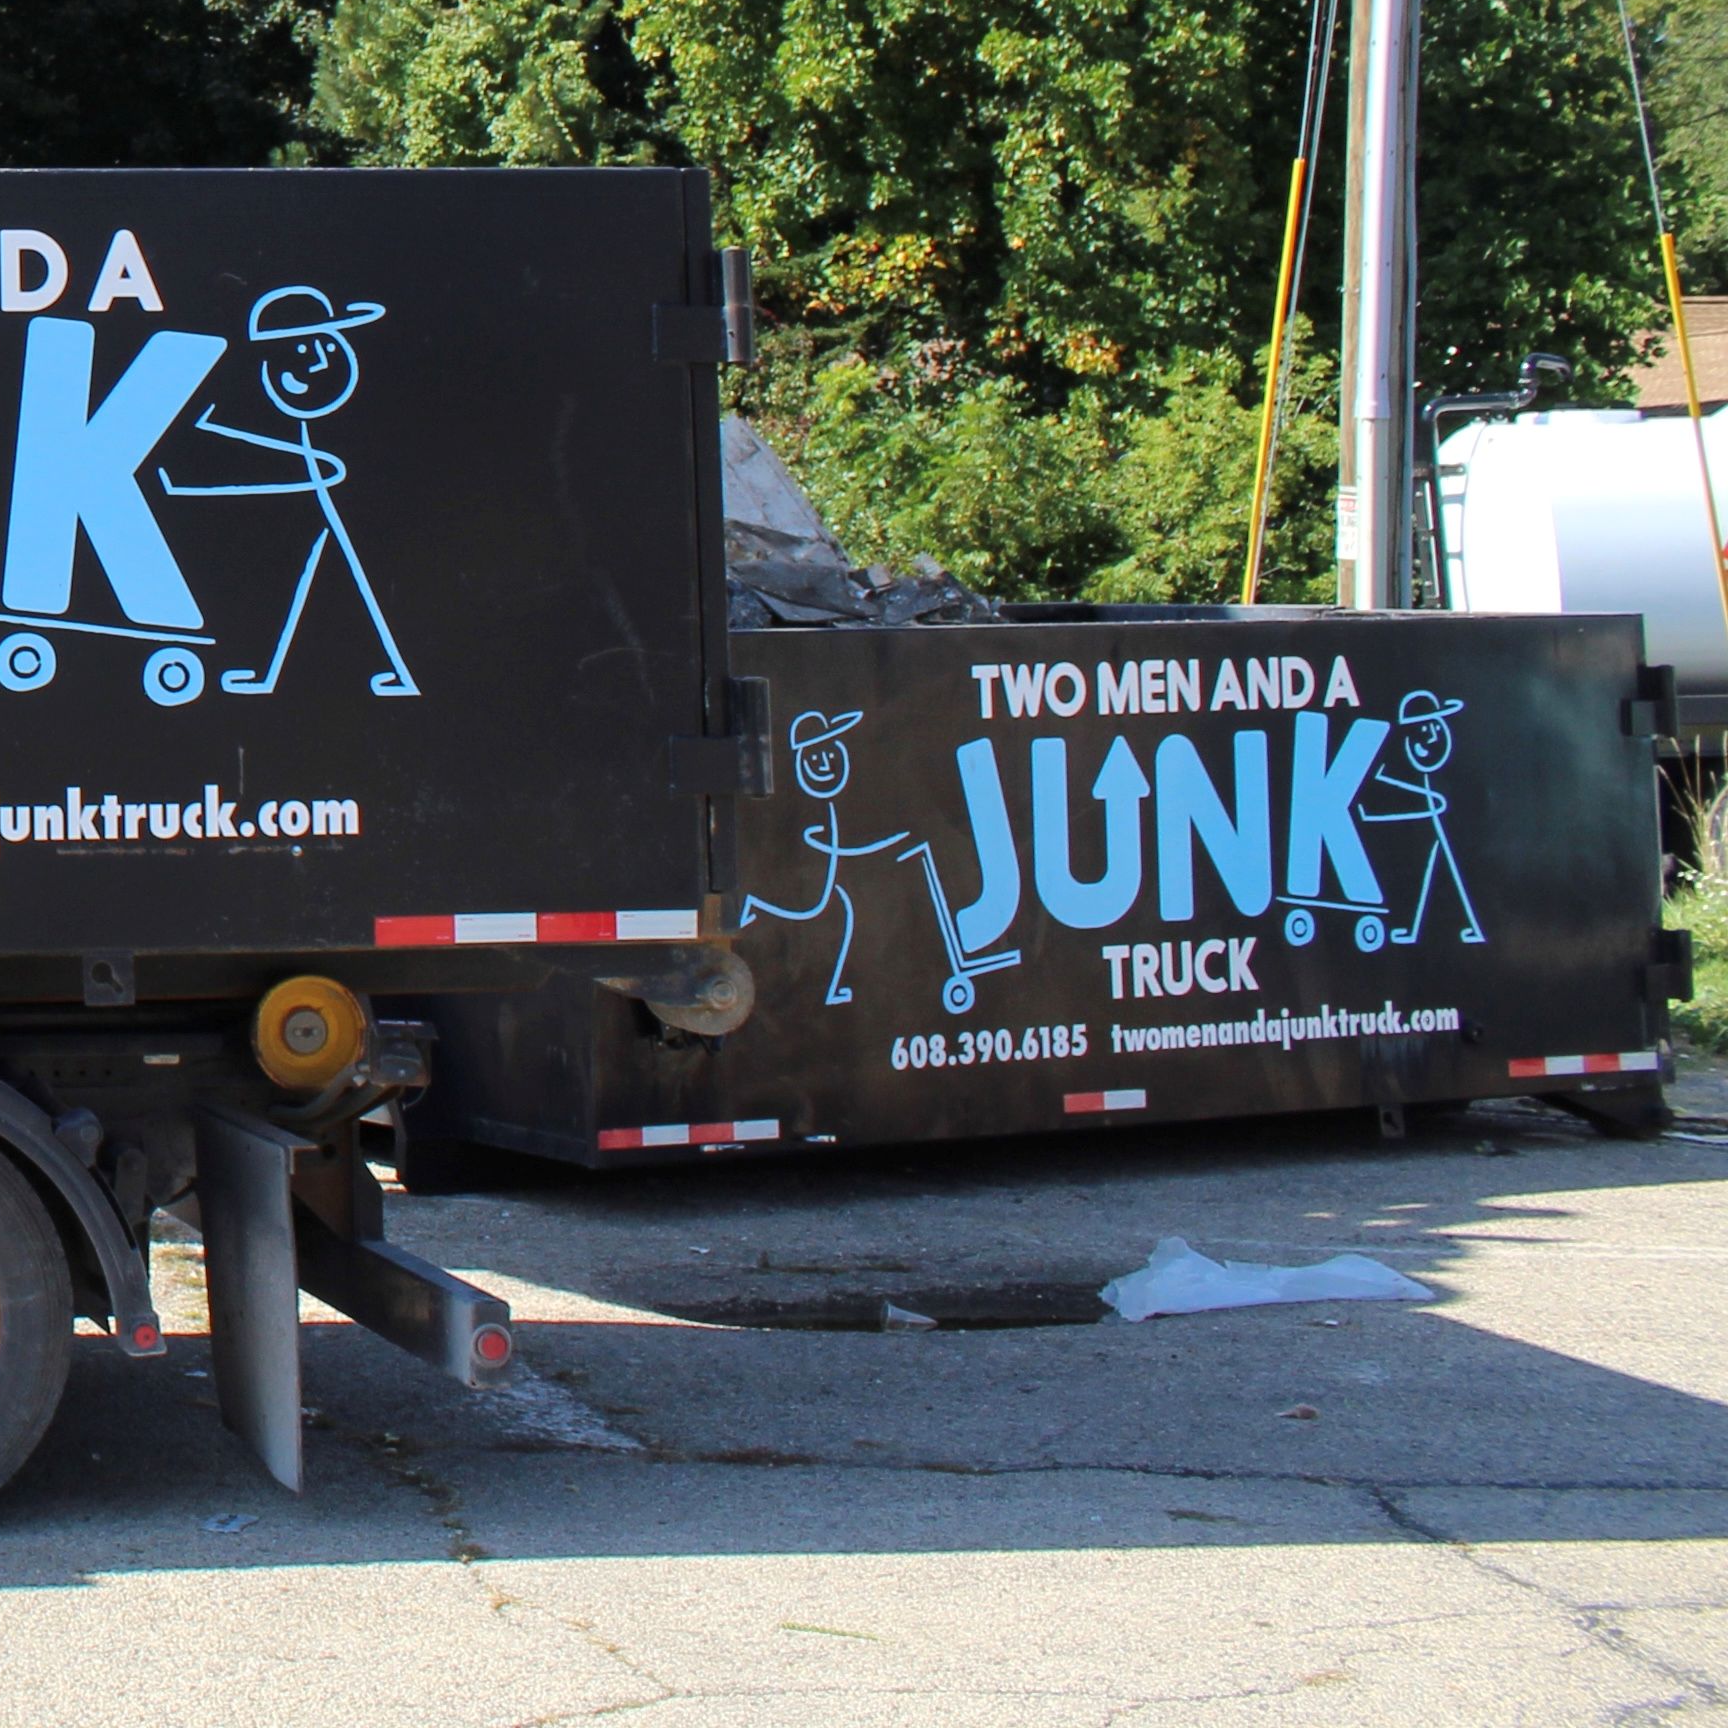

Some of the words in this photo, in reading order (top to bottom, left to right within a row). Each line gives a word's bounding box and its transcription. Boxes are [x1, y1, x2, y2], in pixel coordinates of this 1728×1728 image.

[88, 229, 164, 312] A
[972, 663, 1086, 719] TWO
[1098, 659, 1201, 715] MEN
[1211, 657, 1315, 712] AND
[1324, 656, 1360, 708] A
[956, 711, 1390, 953] JUNK
[1102, 937, 1259, 999] TRUCK
[890, 1024, 1088, 1071] 608.390.6185
[1111, 1000, 1460, 1052] twomenandajunktruck.com
